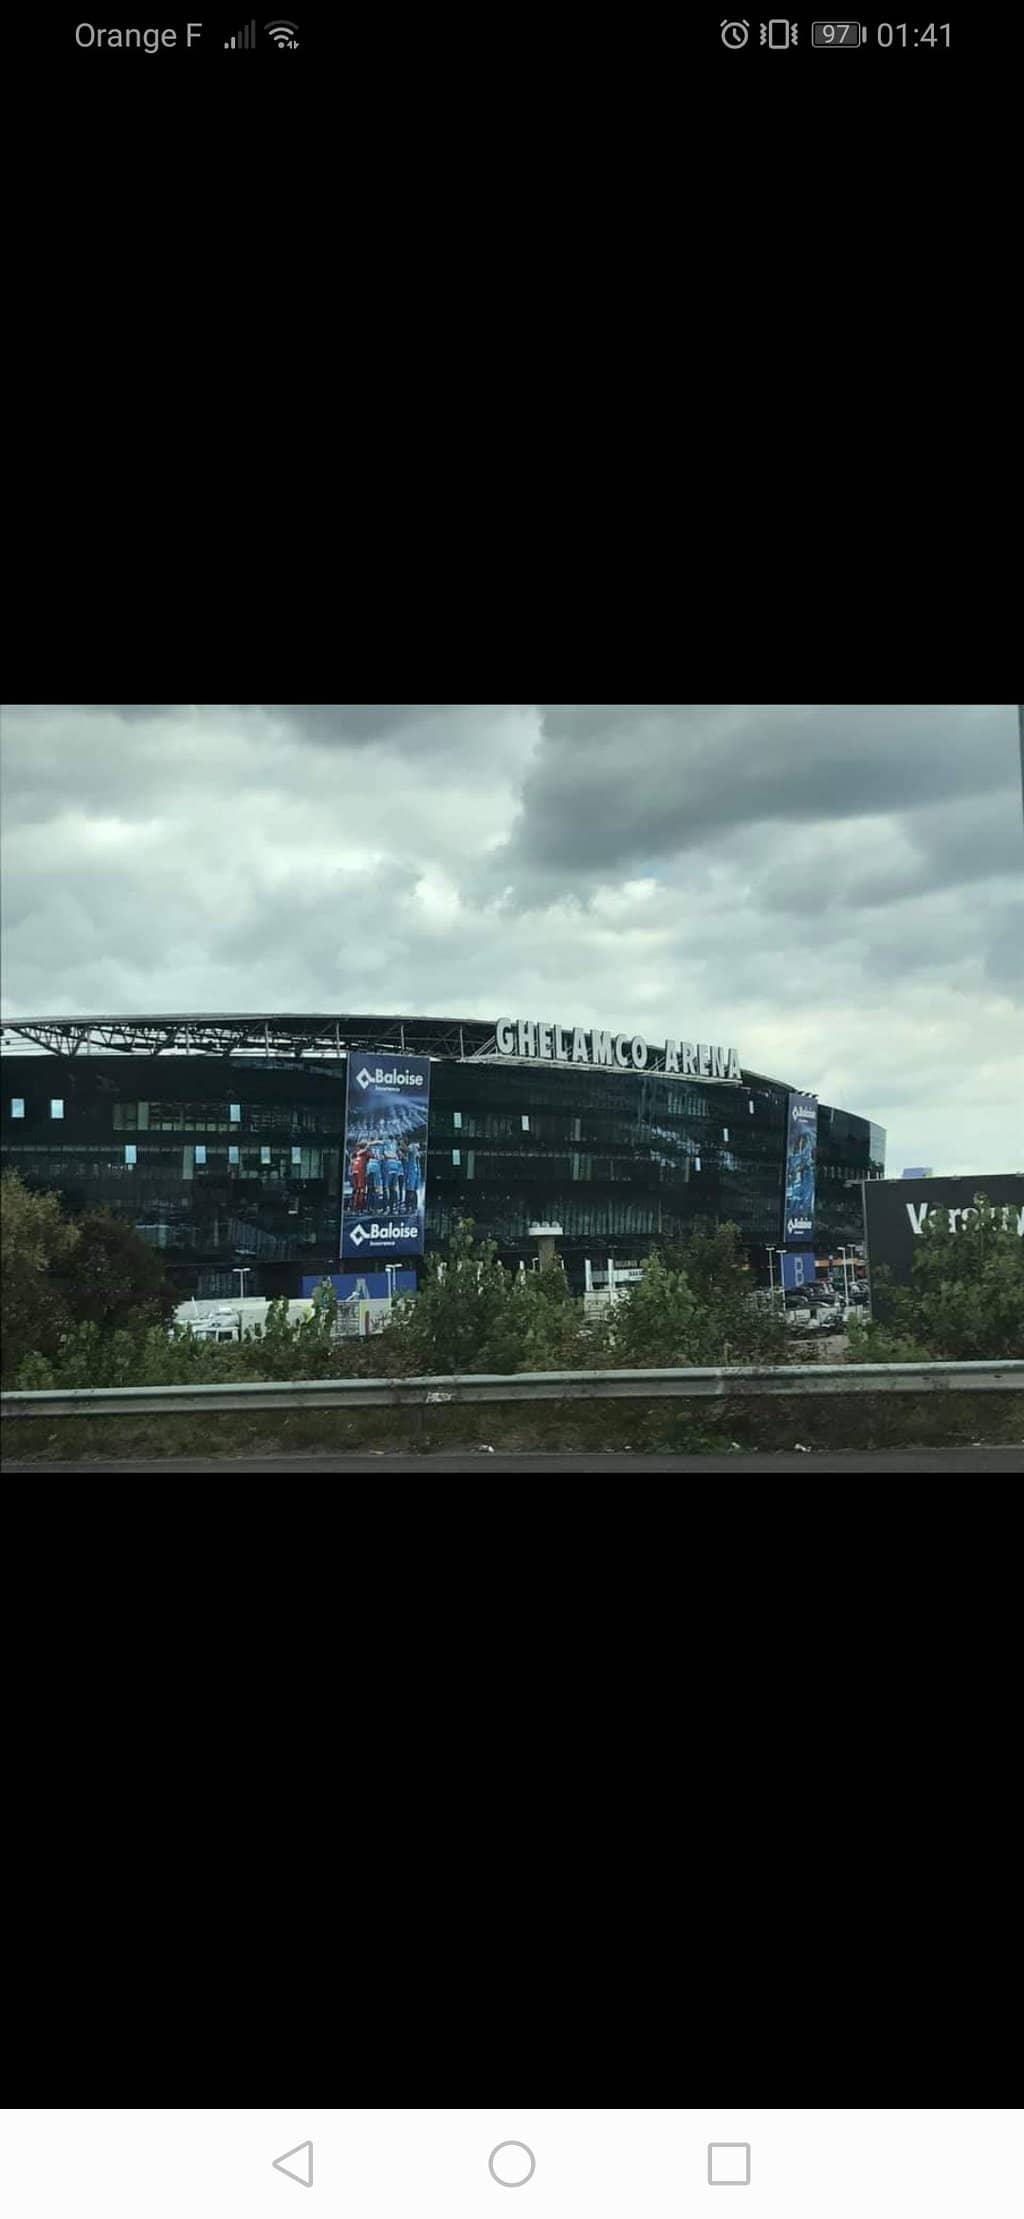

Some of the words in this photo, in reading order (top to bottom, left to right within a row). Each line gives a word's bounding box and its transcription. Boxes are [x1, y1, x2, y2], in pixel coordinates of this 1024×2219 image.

[496, 1017, 648, 1070] GHELAMCO
[665, 1039, 742, 1080] ARENA
[375, 1068, 424, 1086] Baloise
[370, 1222, 419, 1239] Baloise
